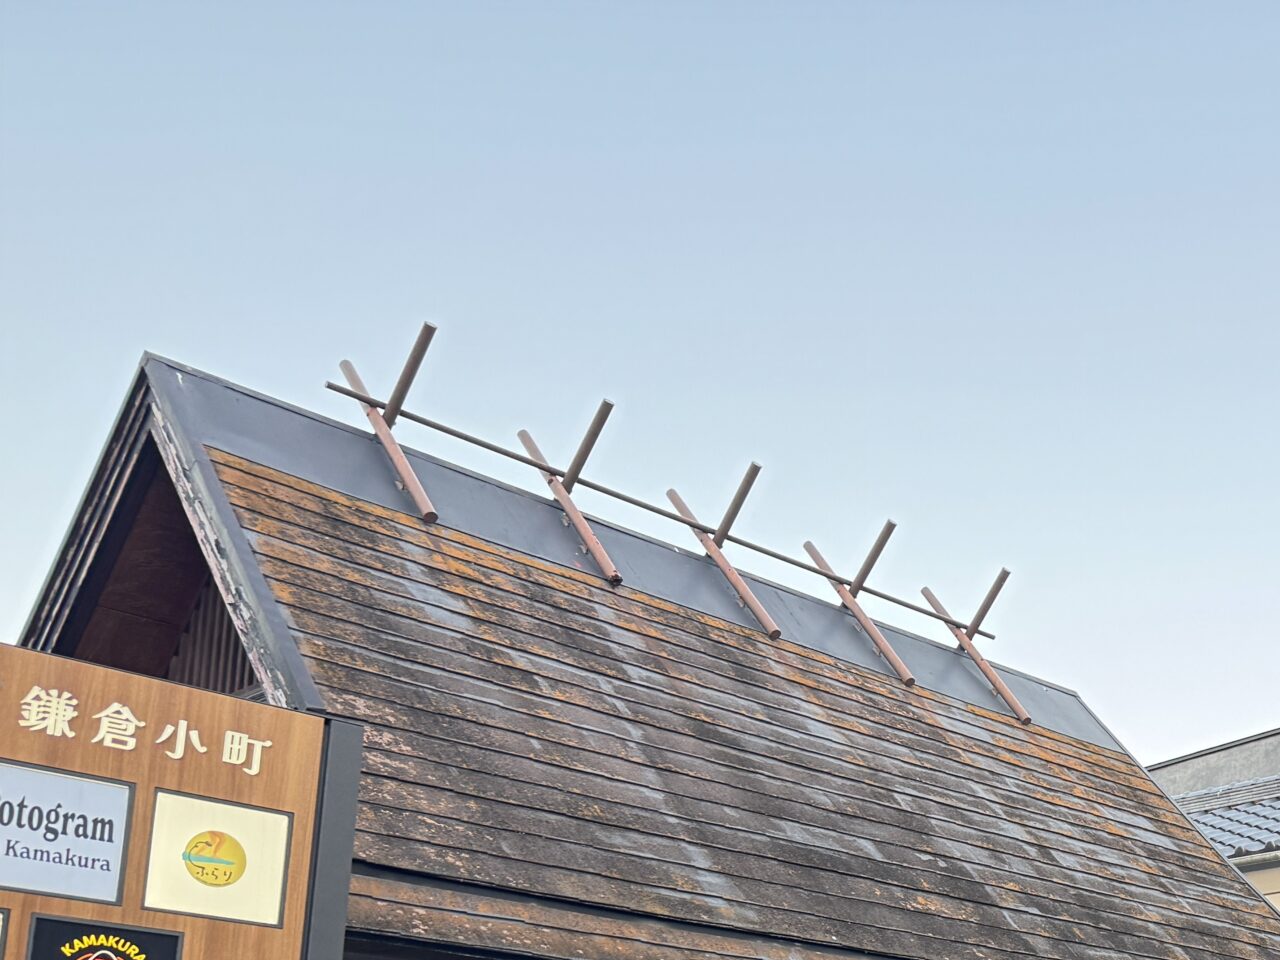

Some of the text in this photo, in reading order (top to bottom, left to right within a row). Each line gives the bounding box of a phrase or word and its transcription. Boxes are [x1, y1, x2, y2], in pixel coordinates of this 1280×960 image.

[18, 685, 273, 776] 鎌倉小町
[0, 795, 114, 843] otogram
[5, 839, 111, 872] Kamakura
